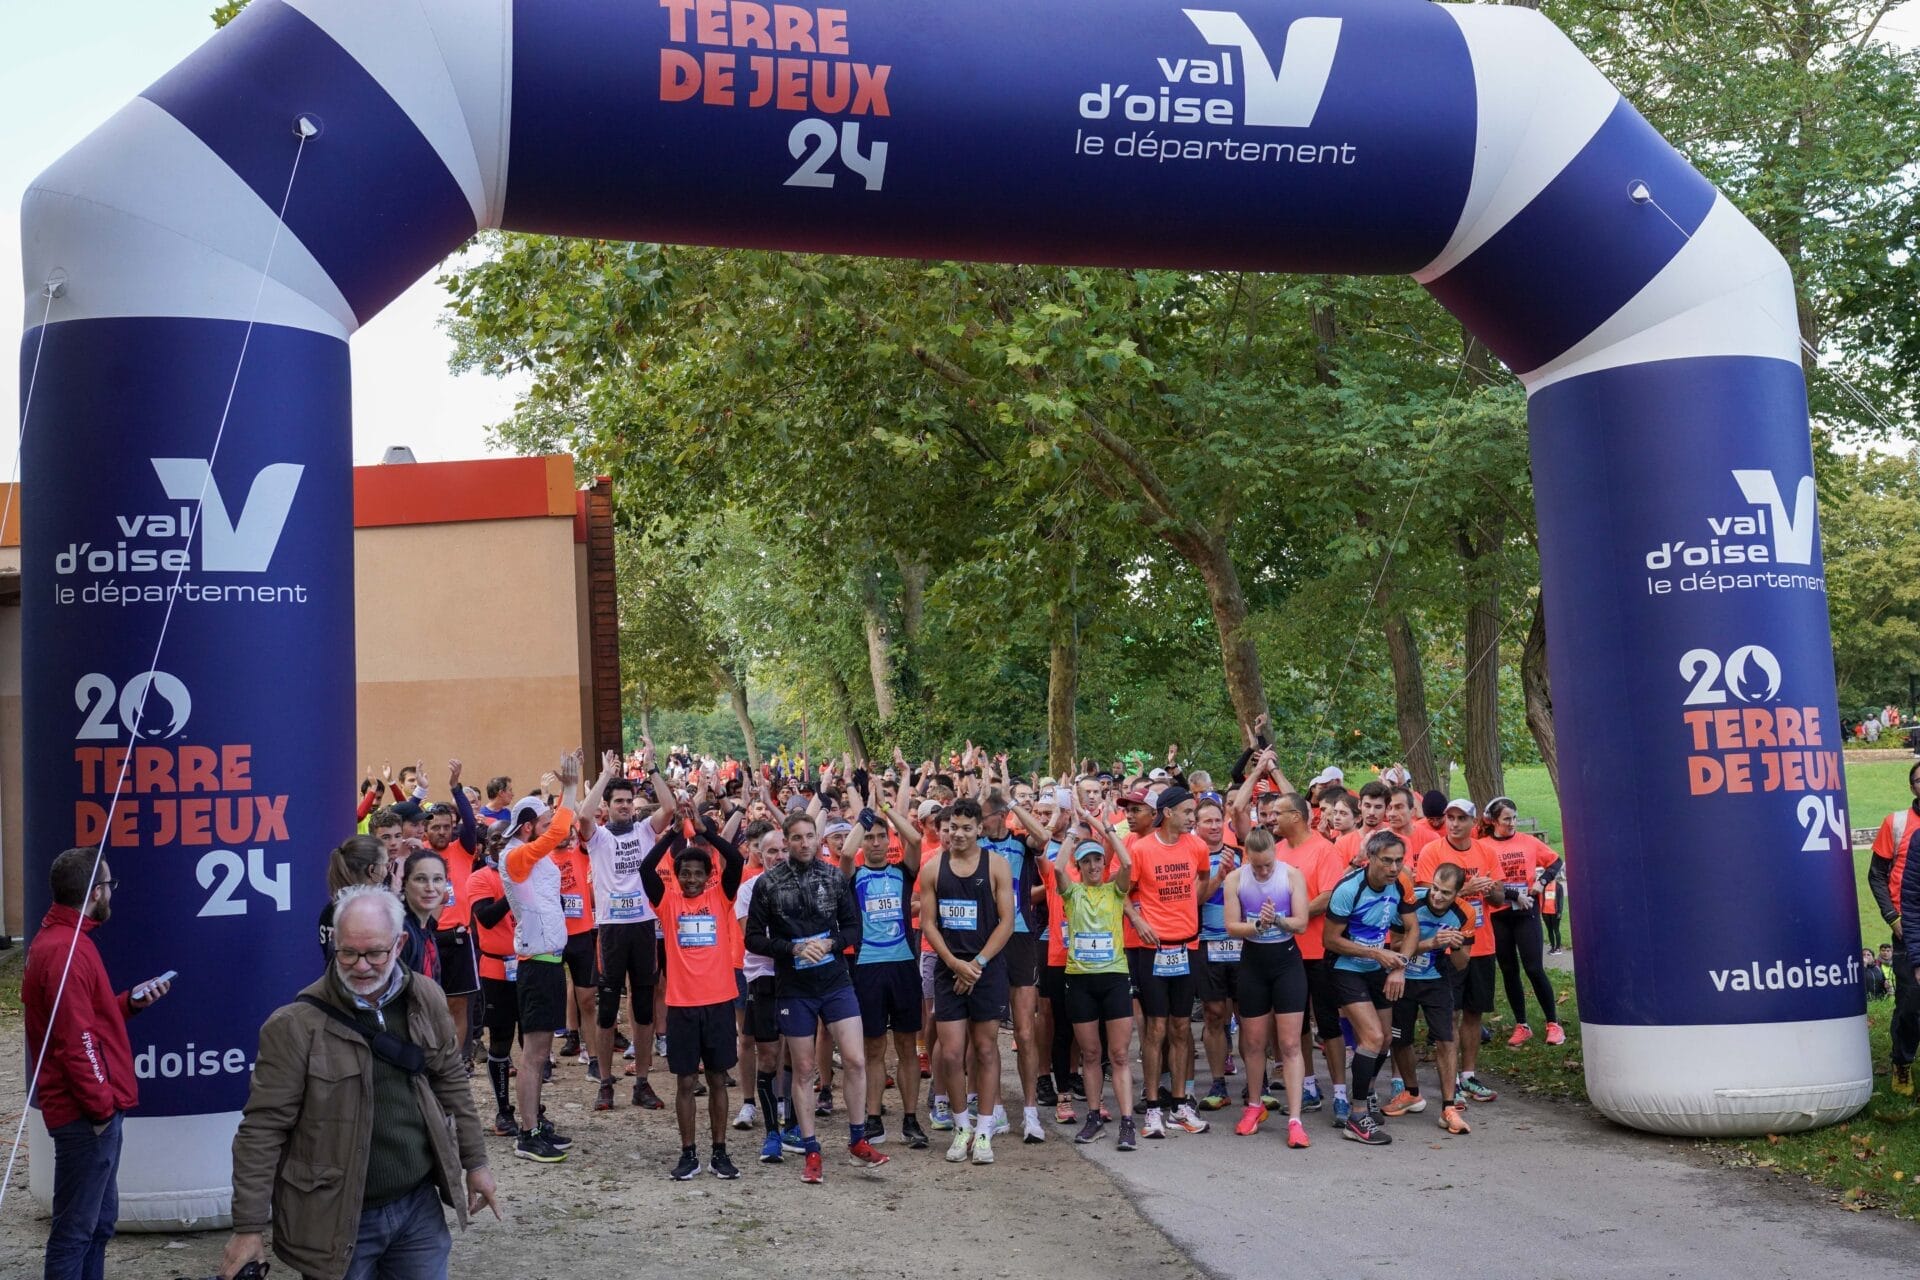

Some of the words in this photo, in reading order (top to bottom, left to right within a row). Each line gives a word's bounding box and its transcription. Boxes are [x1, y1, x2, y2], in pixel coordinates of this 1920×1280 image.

[660, 0, 849, 55] TERRE
[660, 48, 736, 106] DE
[749, 55, 892, 116] JEUX
[1156, 52, 1233, 85] val
[1079, 83, 1233, 125] d'oise
[782, 118, 889, 191] 24
[1075, 129, 1104, 155] le
[1114, 130, 1357, 165] département
[116, 506, 190, 537] val
[1707, 509, 1766, 536] val
[55, 541, 191, 575] d'oise
[1645, 539, 1769, 570] d'oise
[55, 583, 75, 605] le
[82, 580, 307, 606] département
[1647, 577, 1672, 595] le
[1683, 706, 1822, 750] TERRE
[74, 744, 252, 794] TERRE
[1687, 753, 1753, 796] DE
[1761, 751, 1841, 792] JEUX
[75, 800, 140, 847] DE
[153, 795, 290, 847] JEUX
[1797, 795, 1848, 852] 24
[195, 848, 291, 918] 24
[1165, 862, 1189, 872] DONNE
[621, 898, 634, 908] 219
[878, 898, 892, 910] 315
[949, 906, 965, 917] 500
[695, 922, 700, 933] 1
[1091, 939, 1097, 949] 4
[1166, 954, 1179, 965] 335
[1220, 941, 1234, 951] 376
[1709, 955, 1860, 992] valdoise.fr
[134, 1043, 256, 1079] doise.
